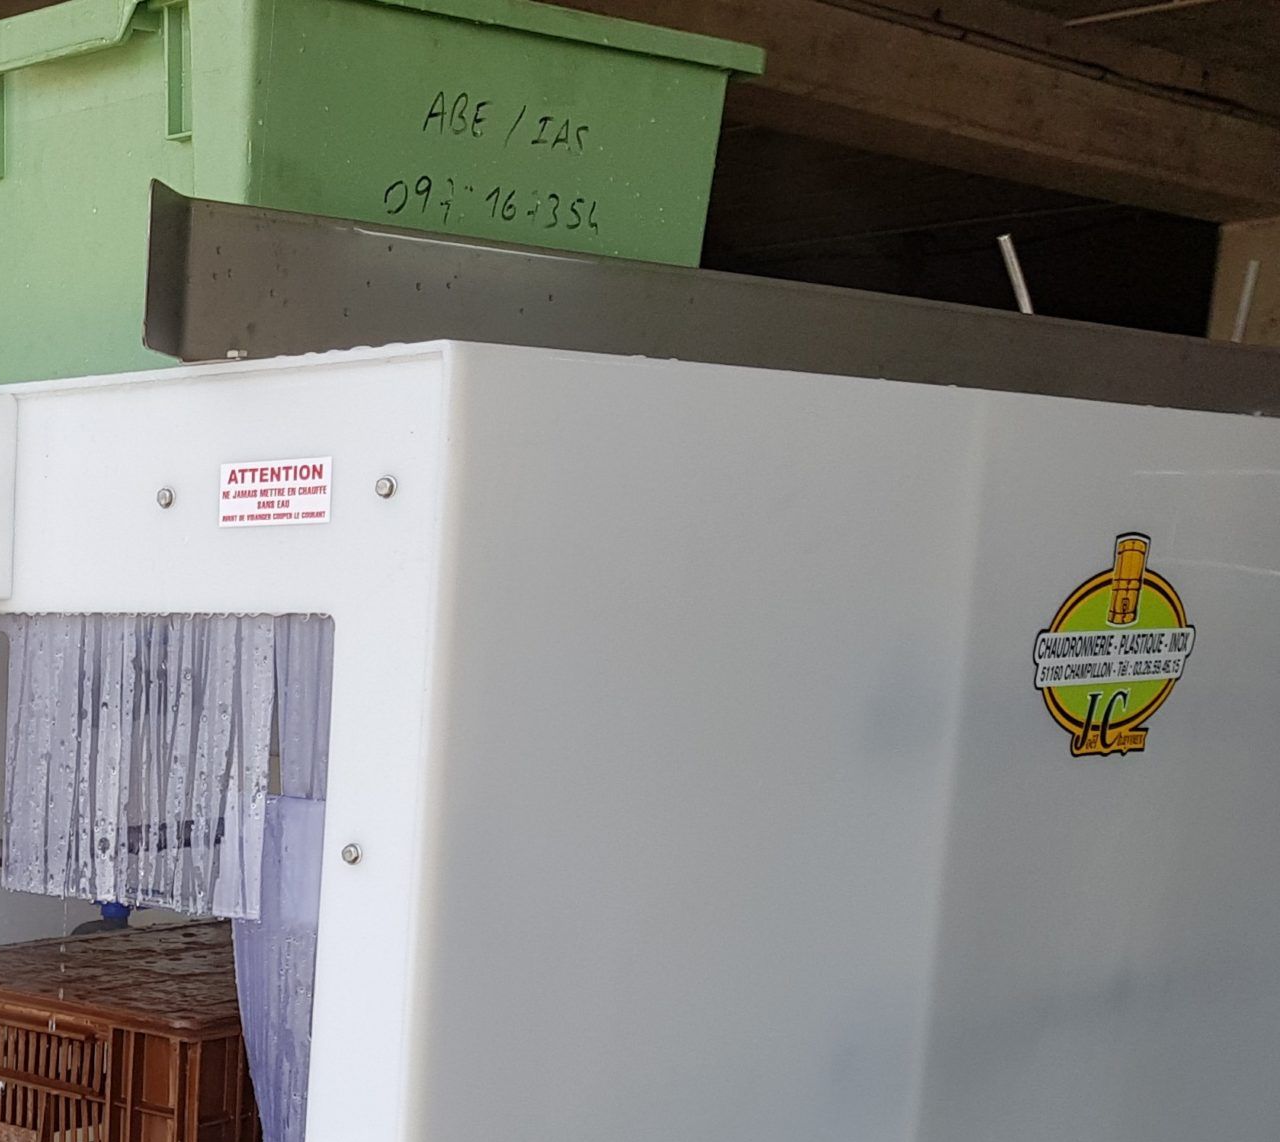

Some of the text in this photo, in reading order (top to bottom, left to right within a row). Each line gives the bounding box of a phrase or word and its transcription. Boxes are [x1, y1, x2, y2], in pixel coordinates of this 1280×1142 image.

[422, 91, 493, 138] ABE
[227, 464, 324, 485] ATTENTION
[222, 485, 327, 499] NE JAMAIS METTRE EN CHAUFFE
[257, 499, 290, 510] SANS EAU
[1038, 634, 1114, 660] CHAUDRONNERIE
[1119, 632, 1165, 655] PLASTIQUE
[1168, 631, 1191, 653] INOX
[1064, 661, 1112, 681] CHAMPILLON
